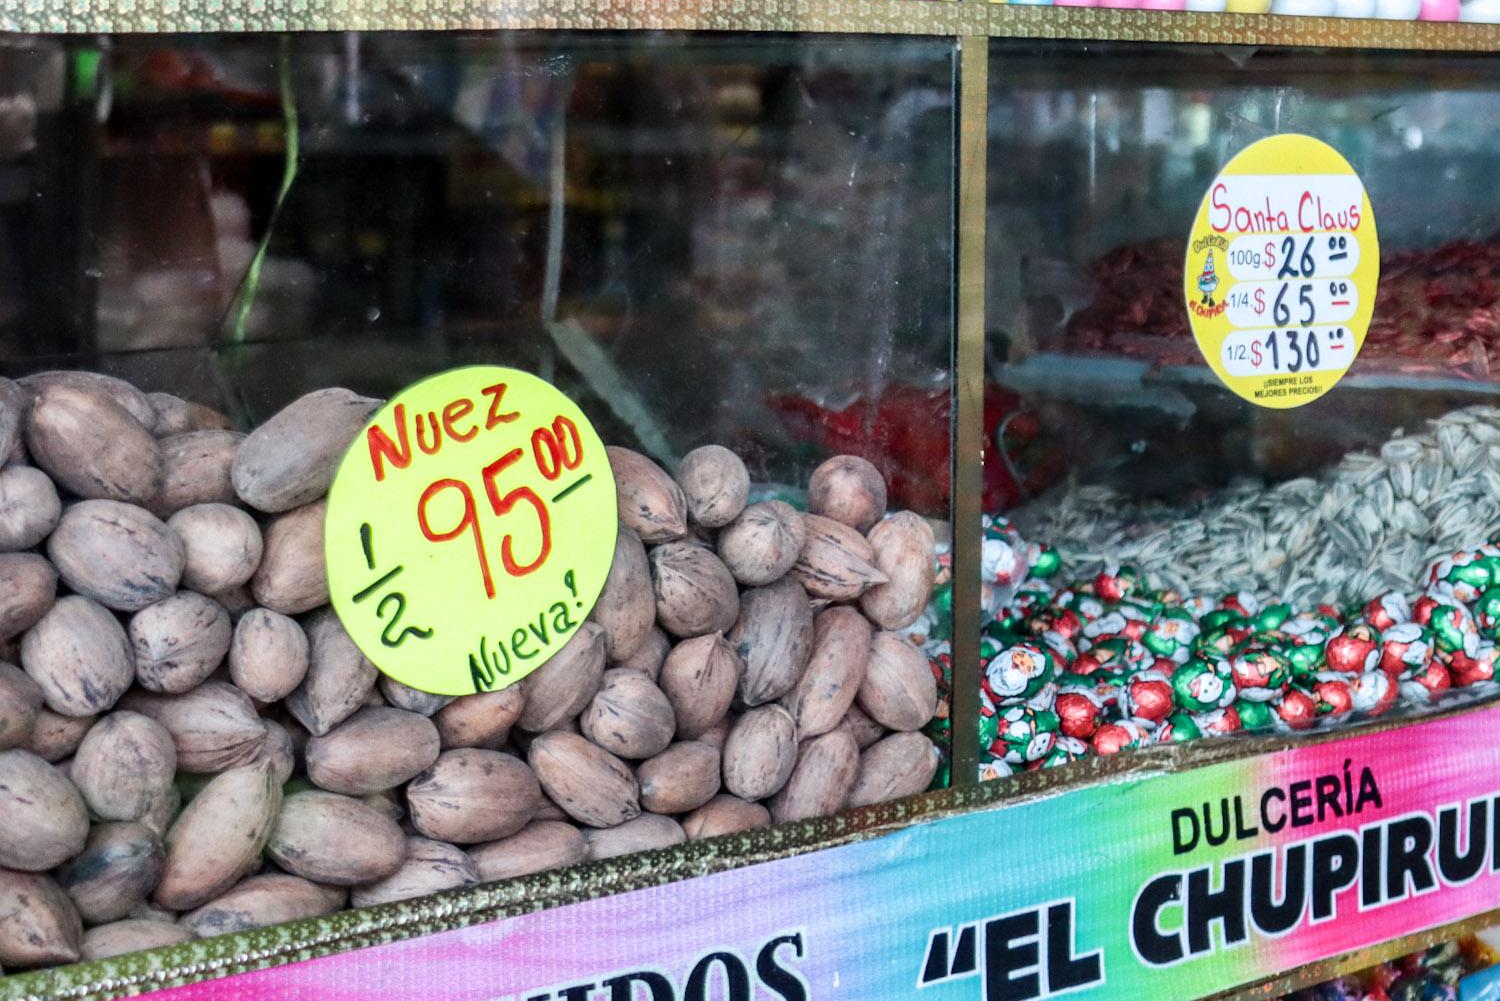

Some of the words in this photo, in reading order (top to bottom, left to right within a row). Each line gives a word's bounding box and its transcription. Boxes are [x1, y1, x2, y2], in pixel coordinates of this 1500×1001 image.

[1211, 183, 1289, 233] Santa
[1298, 191, 1361, 233] Claus
[1255, 388, 1287, 398] MEJORES
[1300, 376, 1313, 384] LOS
[367, 382, 521, 483] Nuez
[469, 568, 584, 694] Nueva!
[1171, 758, 1384, 857] DULCERÍA
